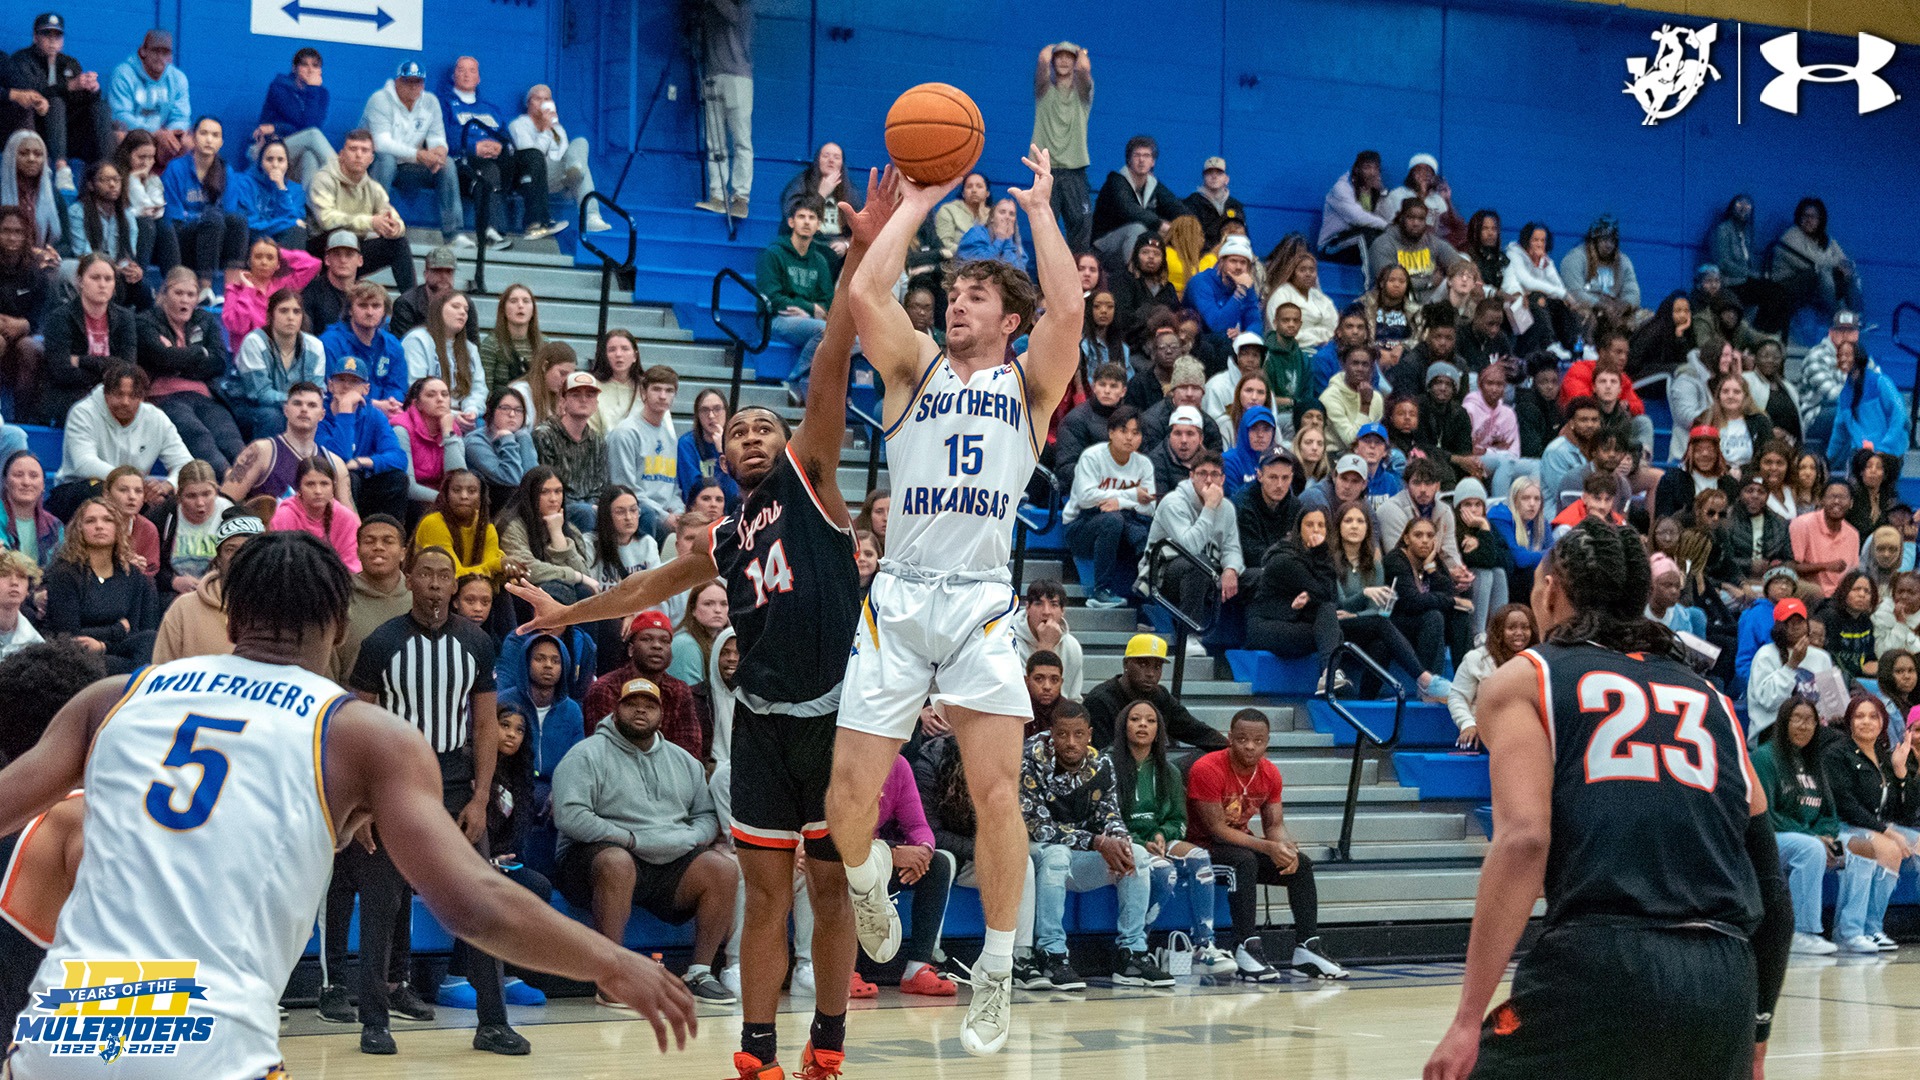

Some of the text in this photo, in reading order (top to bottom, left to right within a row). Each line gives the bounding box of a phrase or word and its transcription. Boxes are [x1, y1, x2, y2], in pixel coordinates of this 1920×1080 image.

[916, 388, 1022, 431] SOUTHERN
[944, 433, 985, 477] 15
[902, 486, 1010, 521] ARKANSAS
[745, 539, 794, 609] 14
[146, 671, 316, 717] MULERIDERS
[1577, 670, 1719, 793] 23
[143, 712, 250, 833] 5
